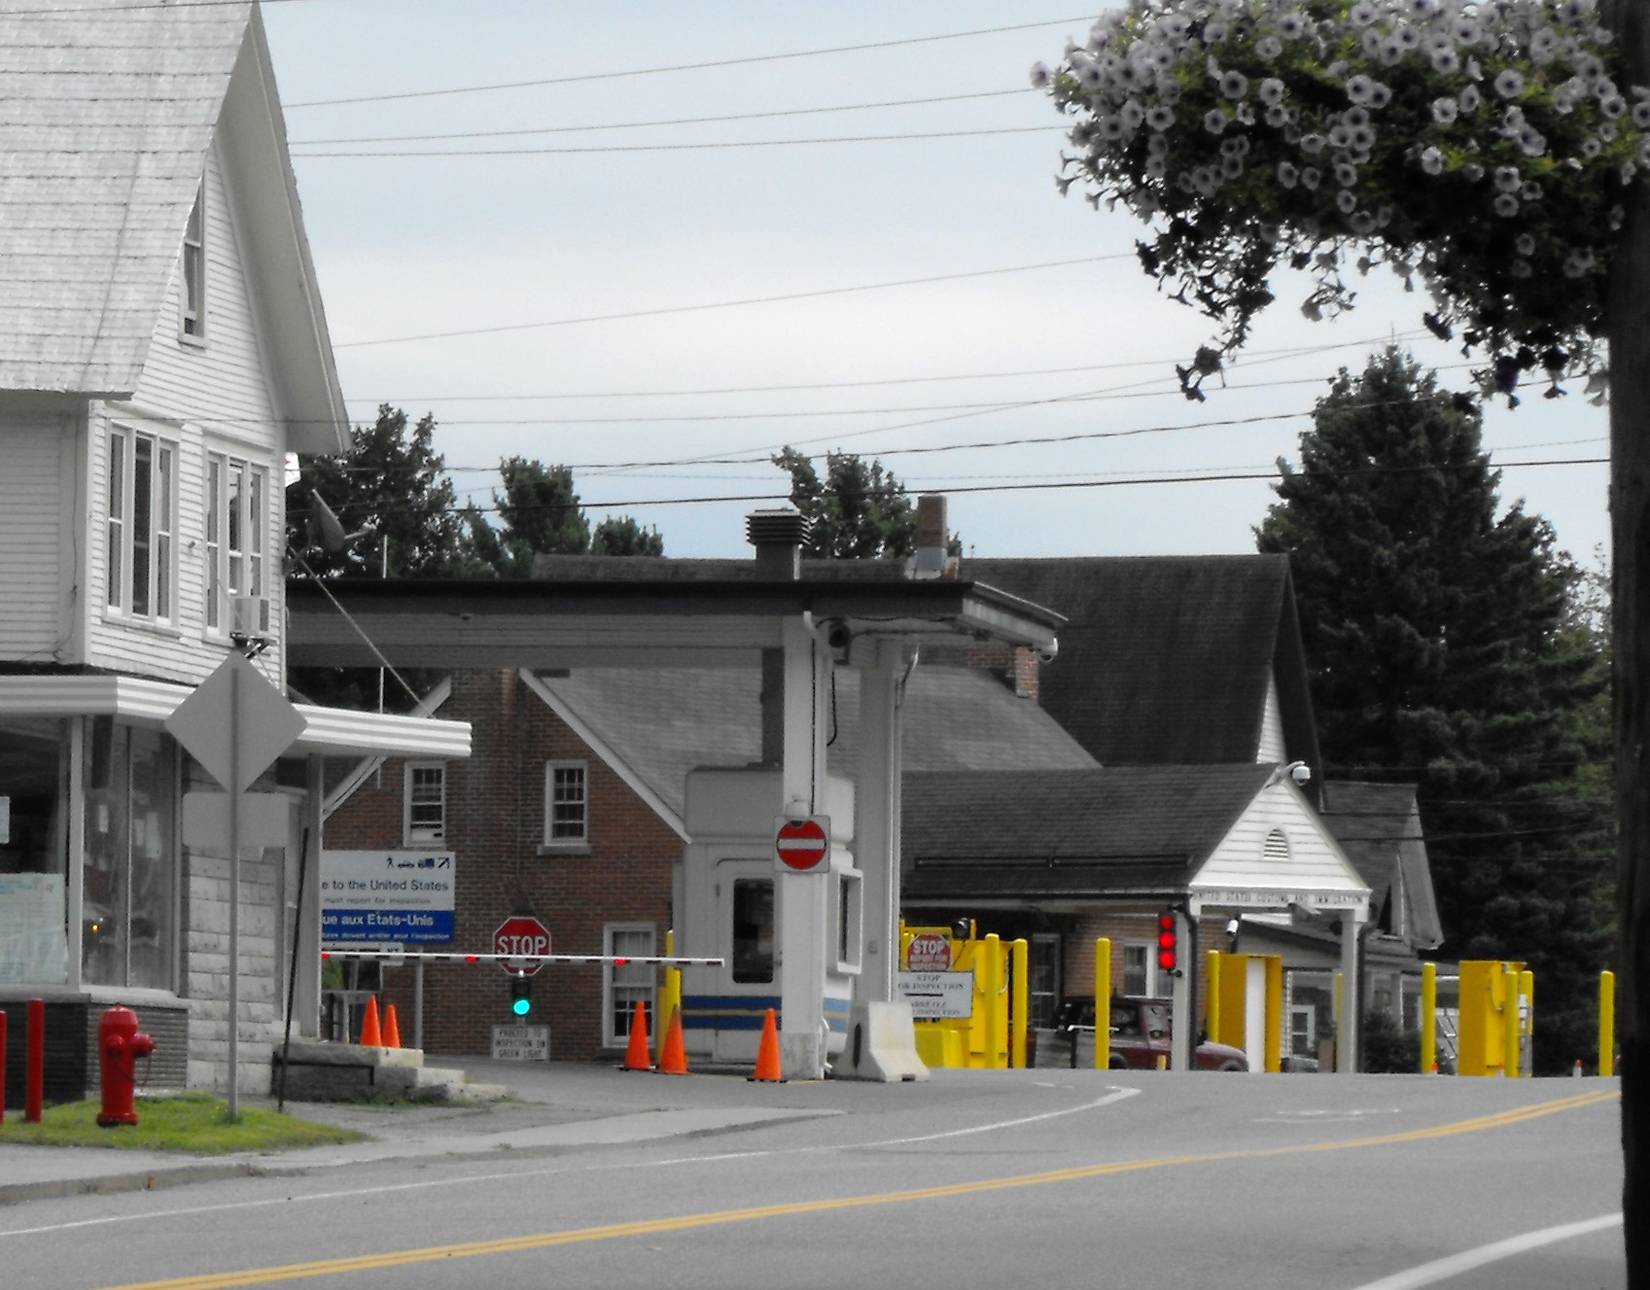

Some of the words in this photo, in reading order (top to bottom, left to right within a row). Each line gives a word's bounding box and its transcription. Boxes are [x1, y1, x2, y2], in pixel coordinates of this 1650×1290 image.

[333, 880, 345, 890] to
[349, 879, 367, 890] the
[370, 879, 407, 890] United
[410, 879, 449, 891] States
[341, 915, 364, 925] aux
[497, 935, 548, 956] STOP
[912, 940, 946, 954] STOP
[917, 974, 942, 982] STOP
